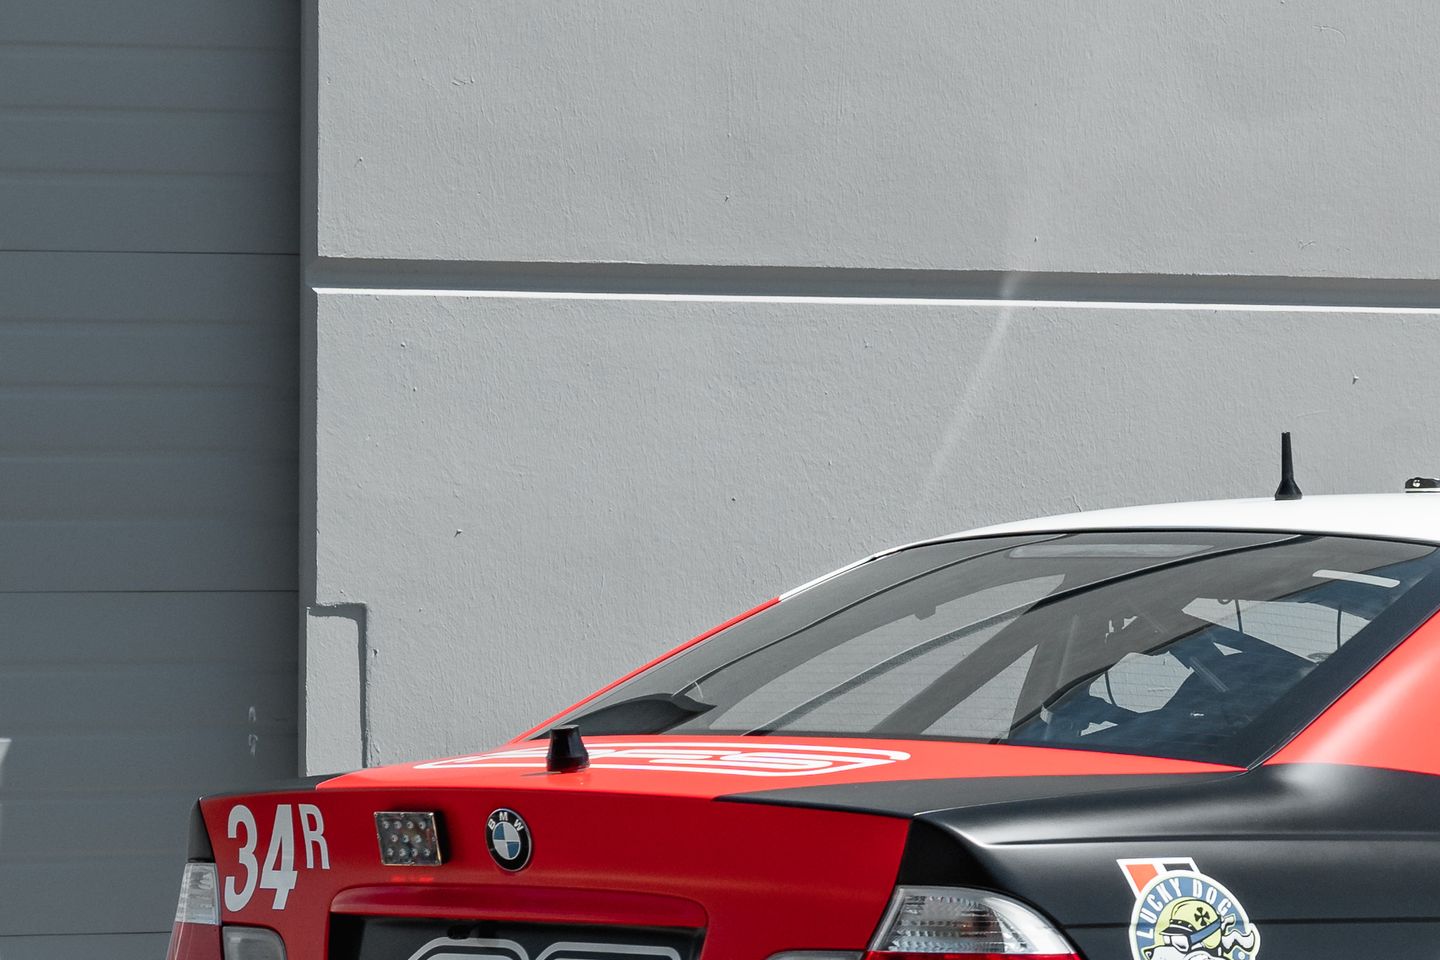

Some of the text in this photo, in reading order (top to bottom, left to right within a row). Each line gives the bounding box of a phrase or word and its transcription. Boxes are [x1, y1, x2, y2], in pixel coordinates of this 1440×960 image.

[487, 811, 525, 831] BMW
[1136, 877, 1233, 939] LUCKY DOG
